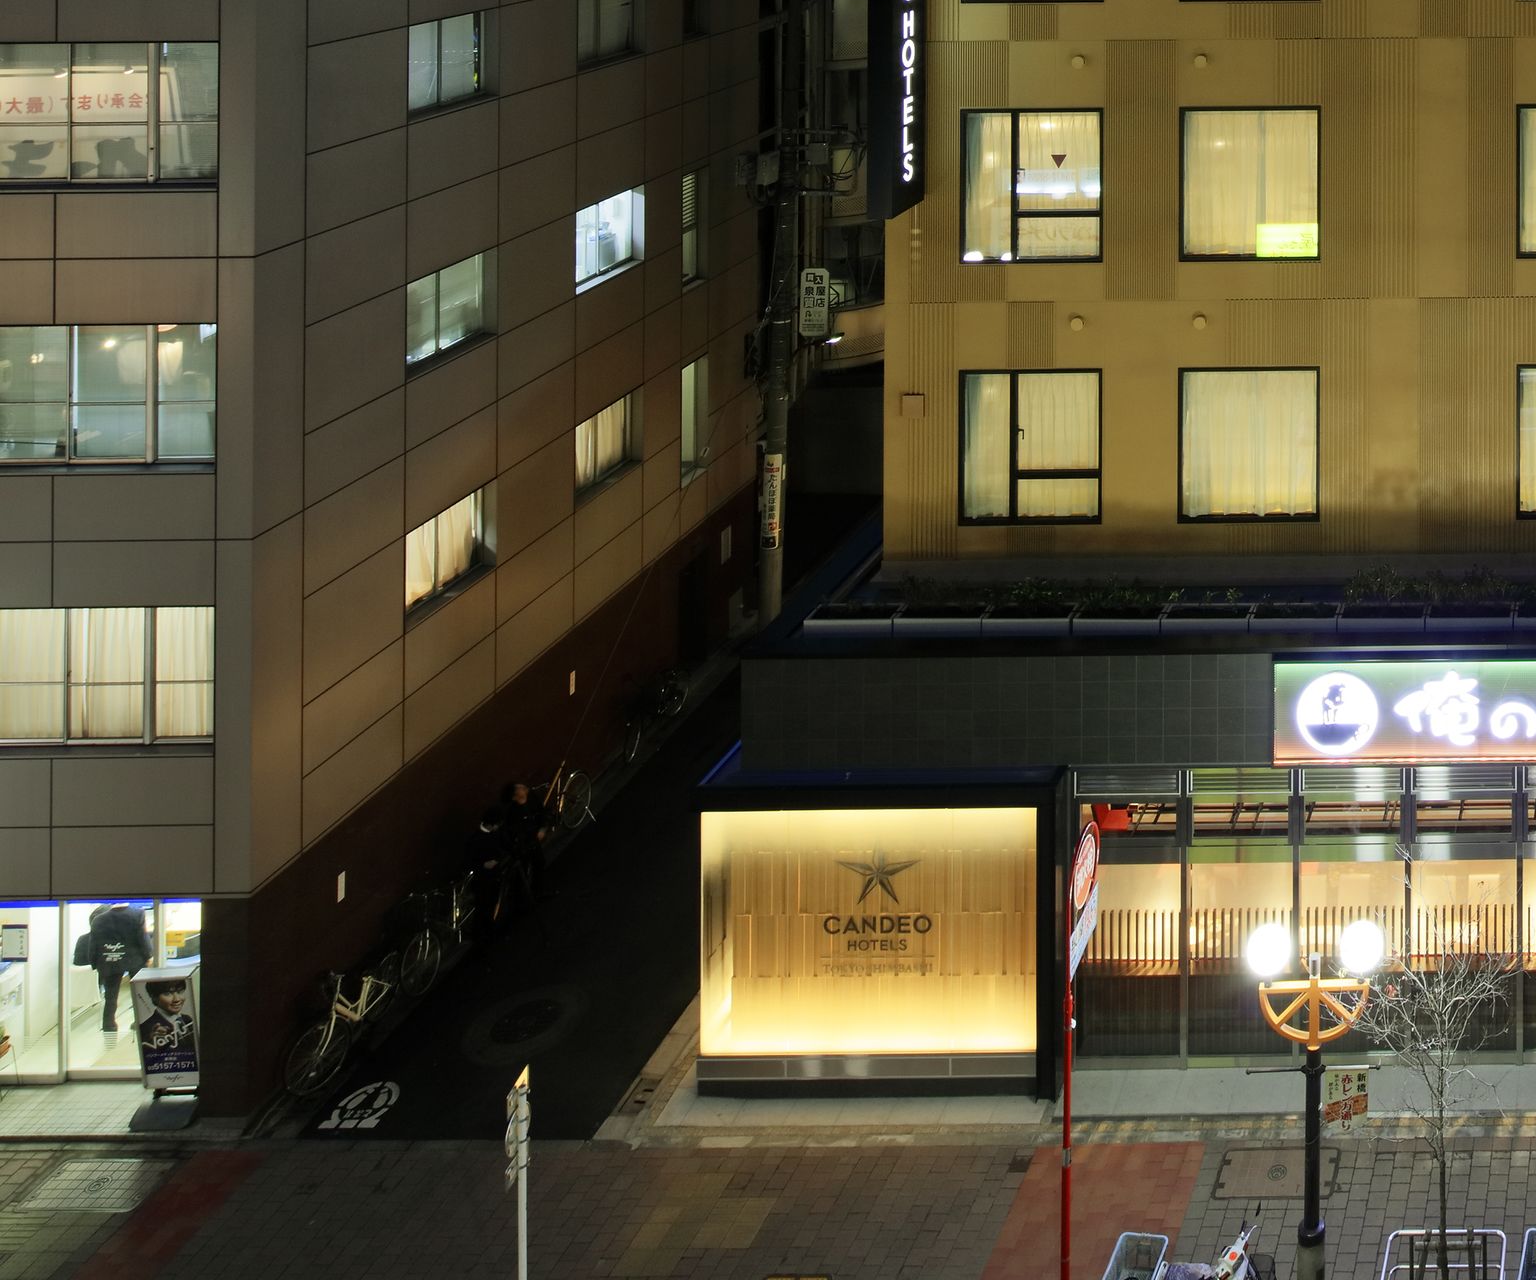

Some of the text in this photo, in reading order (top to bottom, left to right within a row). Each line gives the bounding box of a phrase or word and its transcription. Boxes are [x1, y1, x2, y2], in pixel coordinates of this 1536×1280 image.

[901, 9, 916, 183] HOTELS
[823, 915, 932, 934] CANDEO
[847, 939, 908, 951] HOTELS
[1357, 1073, 1367, 1093] 新橋
[1341, 1074, 1353, 1131] 赤レンガ通り
